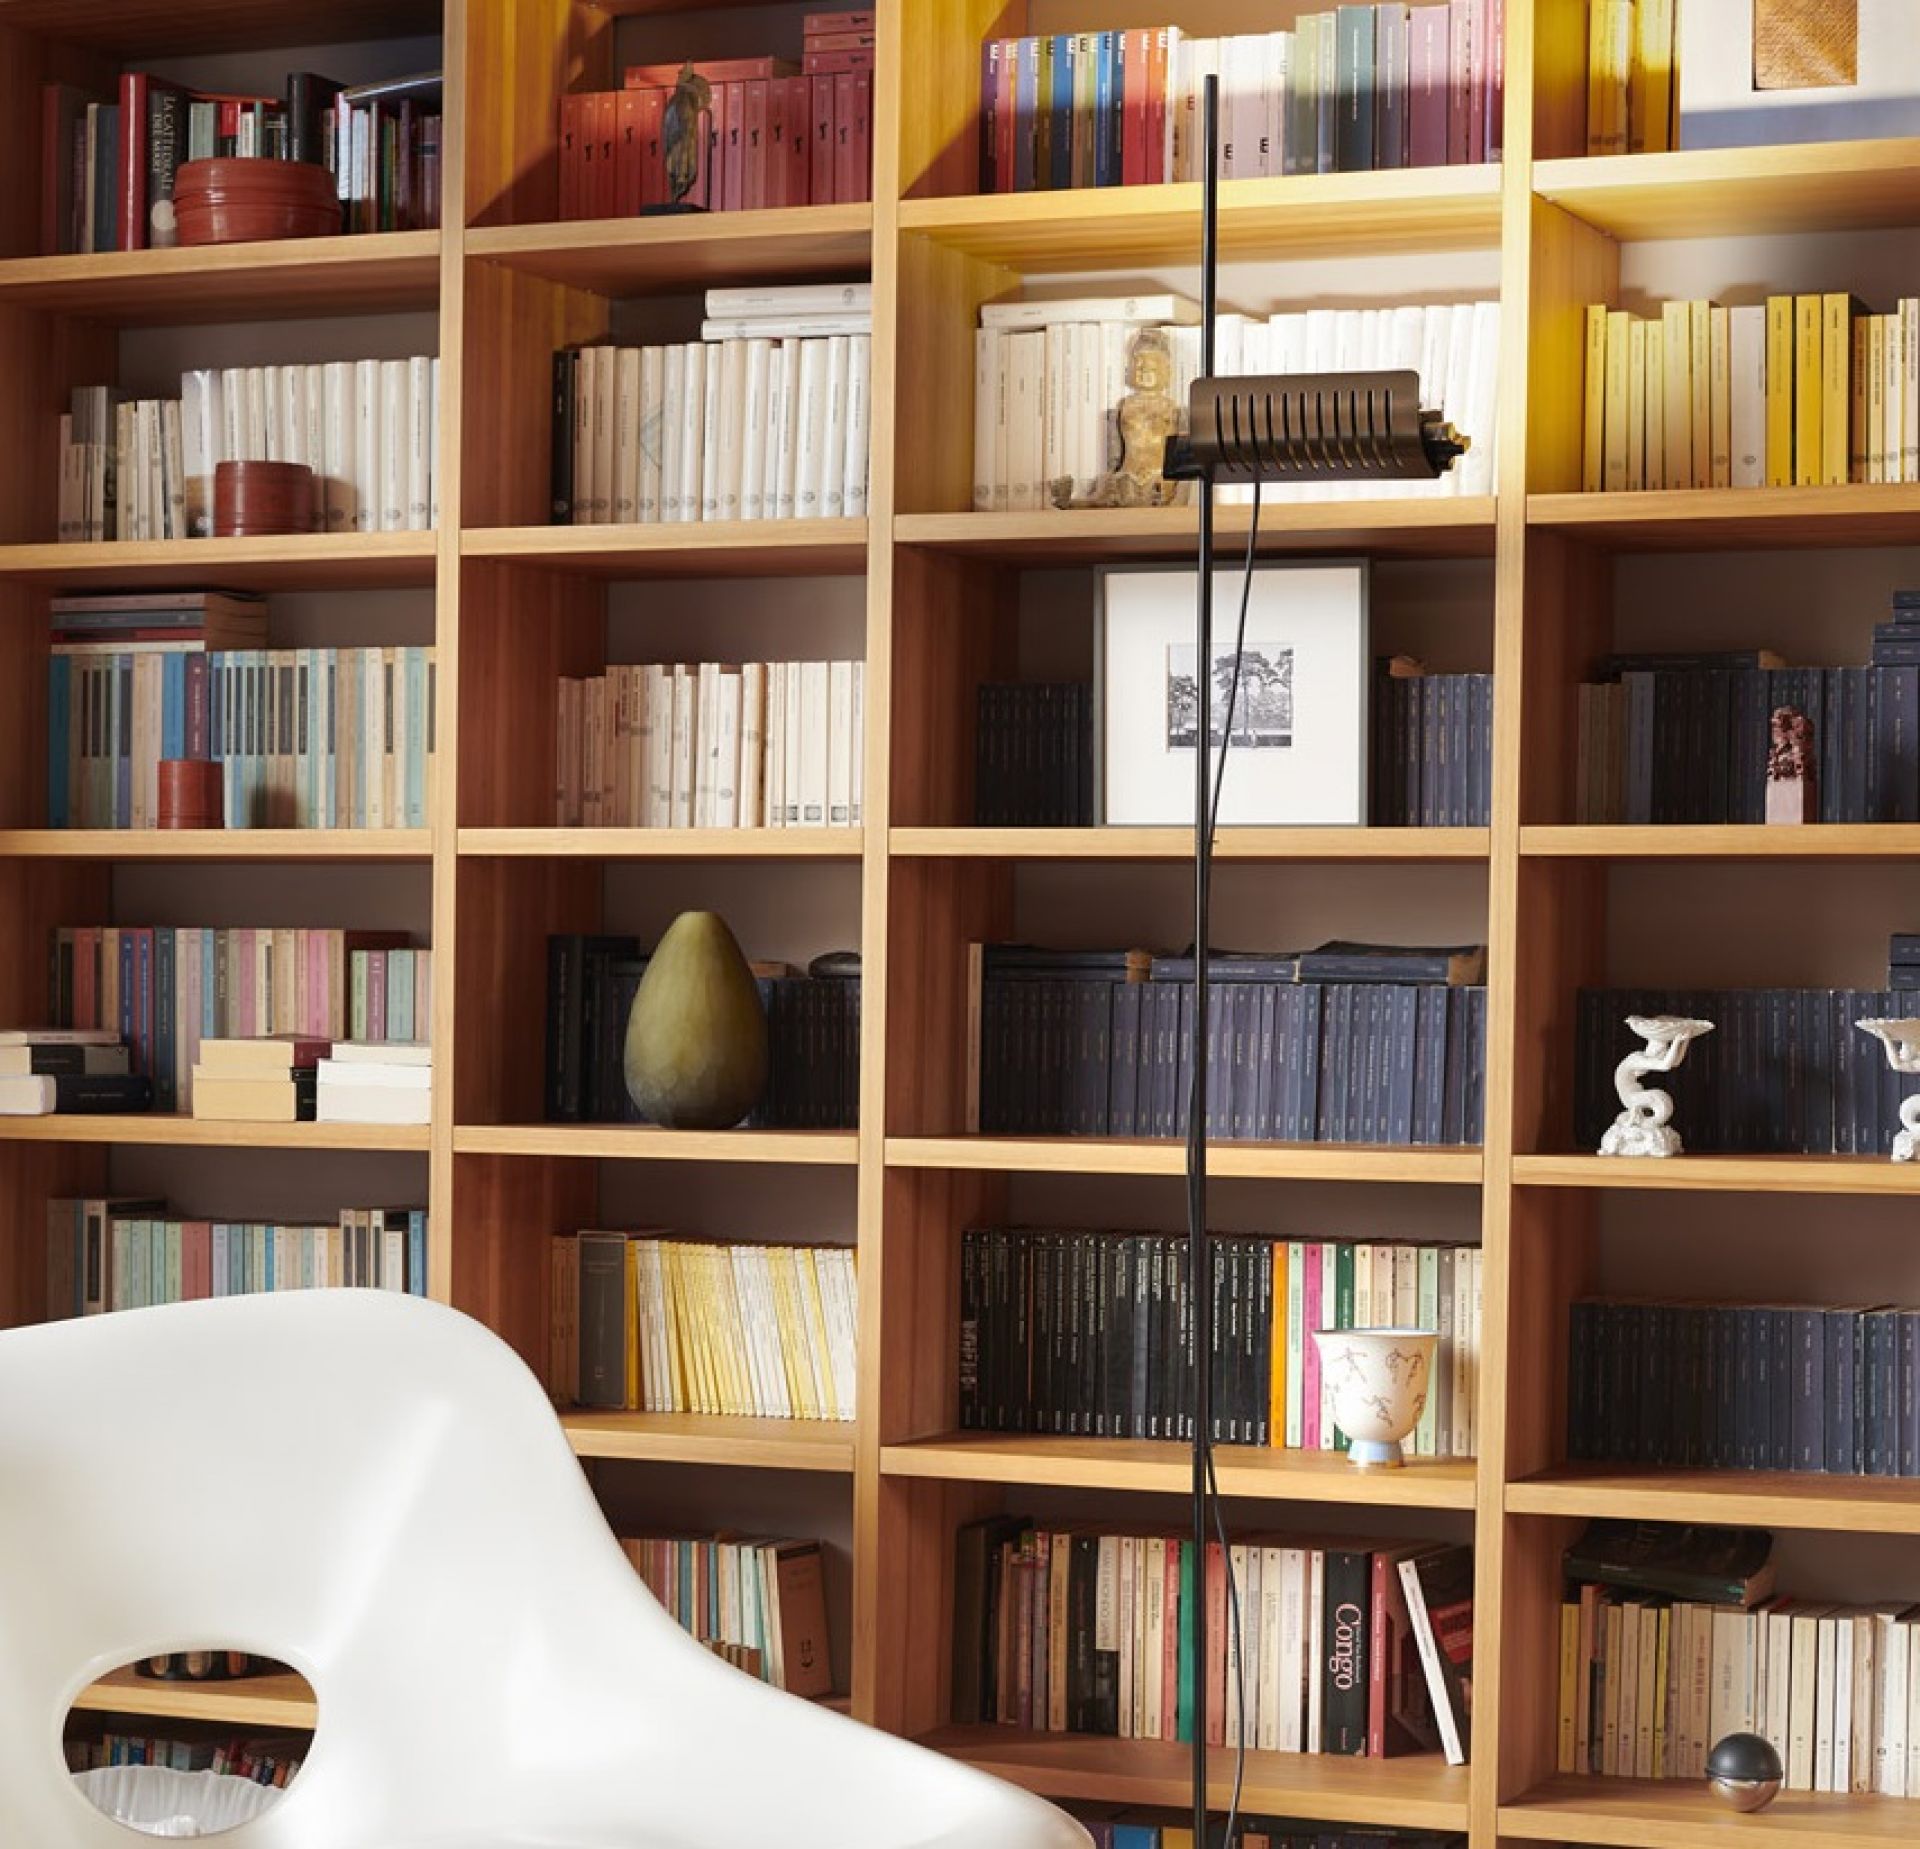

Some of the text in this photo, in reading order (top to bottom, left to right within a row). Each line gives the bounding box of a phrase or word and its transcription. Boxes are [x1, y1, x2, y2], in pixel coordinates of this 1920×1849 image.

[1079, 37, 1088, 52] E
[1187, 96, 1195, 110] E
[1223, 143, 1233, 160] E
[1260, 137, 1269, 153] E
[1329, 1602, 1362, 1690] Congo
